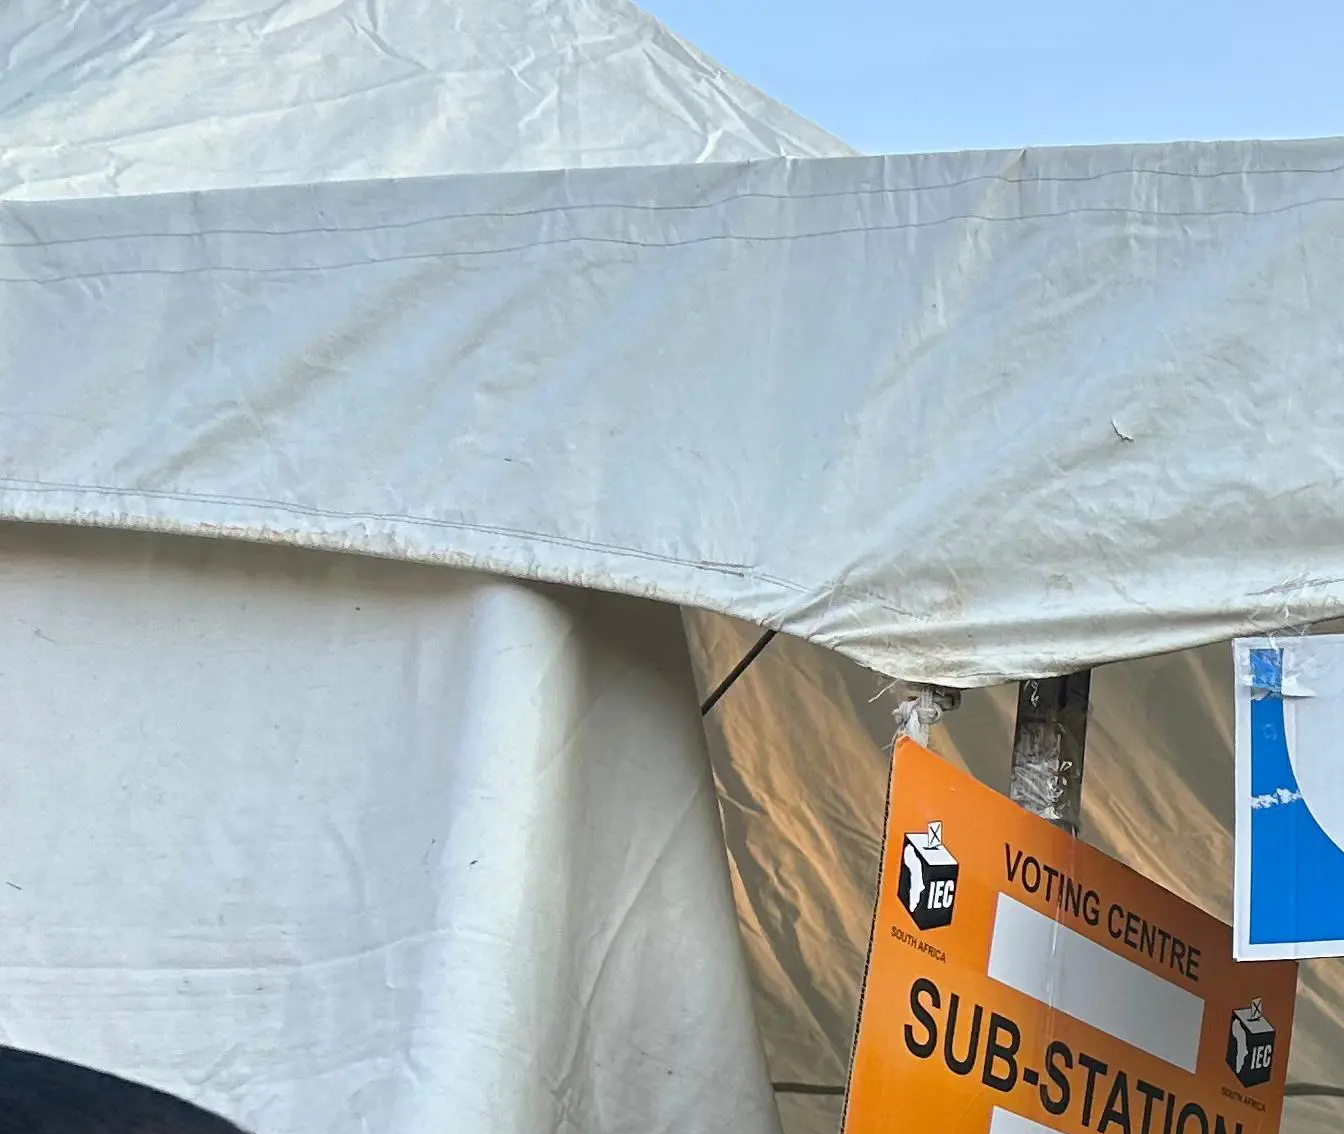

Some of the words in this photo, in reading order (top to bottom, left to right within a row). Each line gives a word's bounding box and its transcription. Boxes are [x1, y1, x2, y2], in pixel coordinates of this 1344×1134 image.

[926, 879, 955, 910] IEC
[1004, 841, 1101, 926] VOTING
[1107, 903, 1202, 982] CENTRE
[890, 925, 918, 950] SOUTH
[917, 941, 947, 963] AFRICA
[1250, 1044, 1273, 1071] IEC
